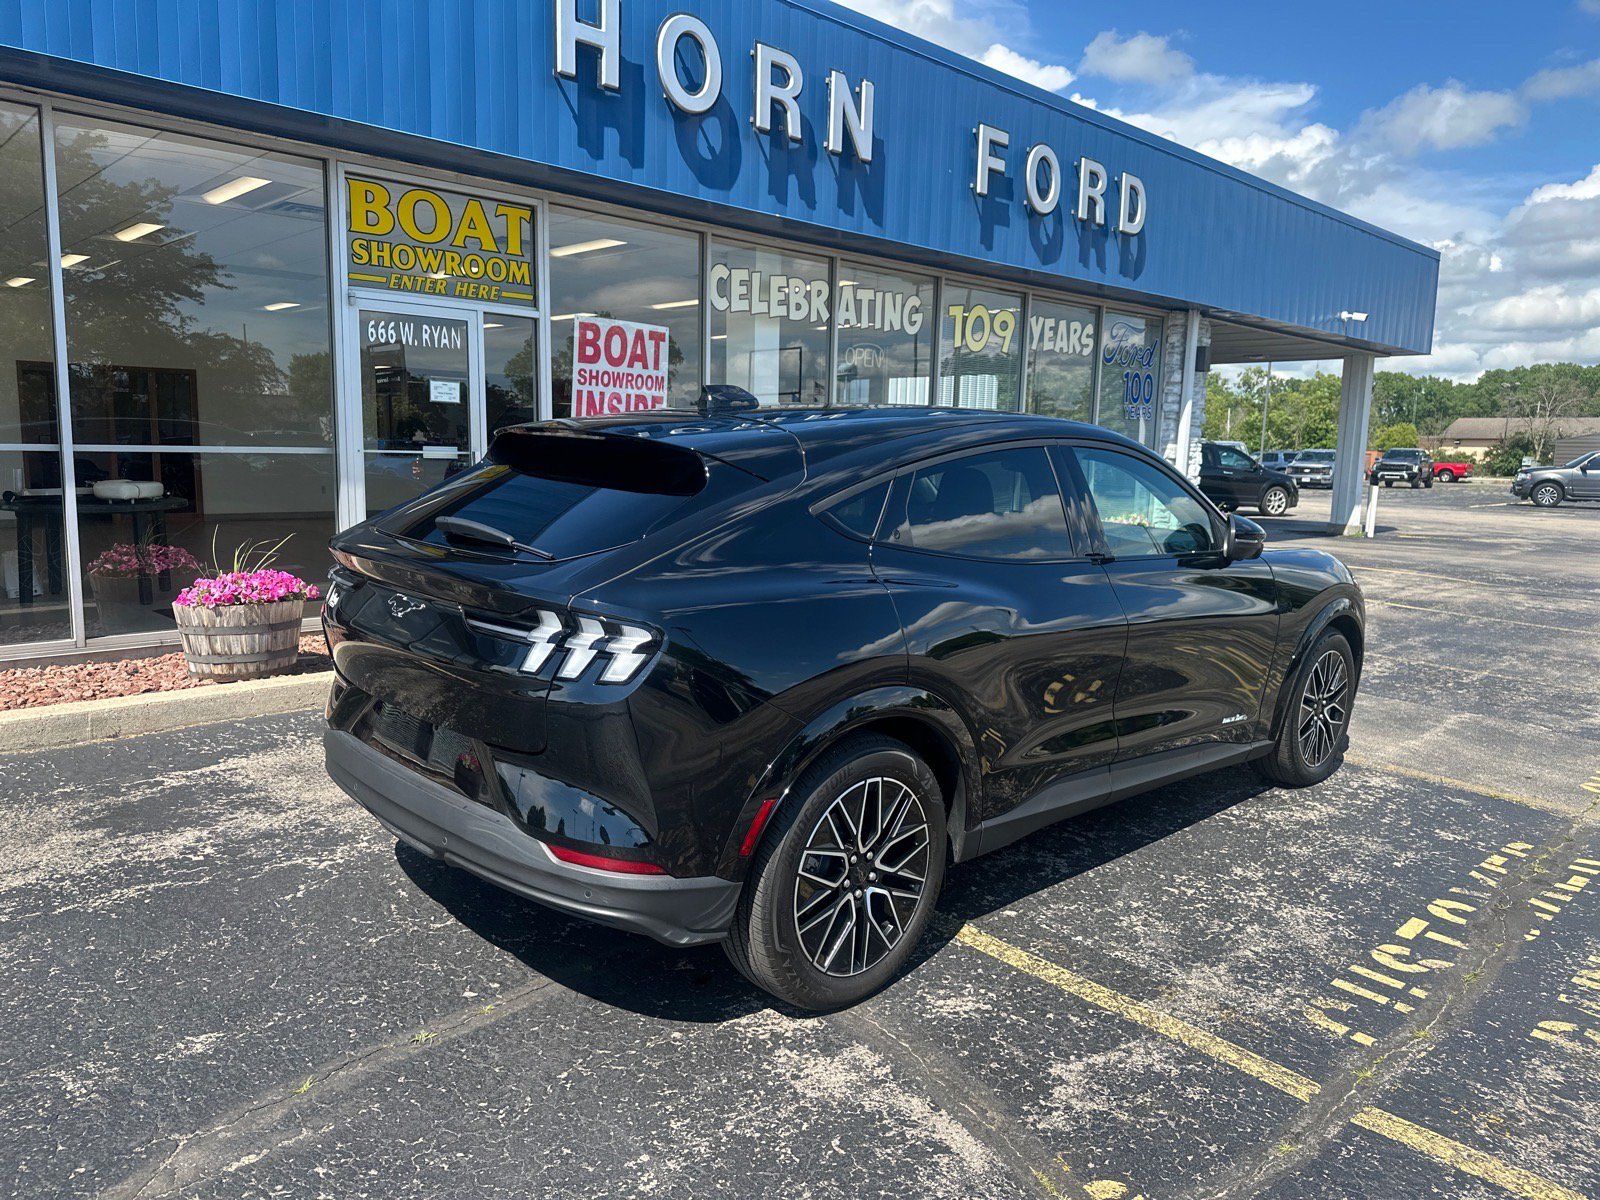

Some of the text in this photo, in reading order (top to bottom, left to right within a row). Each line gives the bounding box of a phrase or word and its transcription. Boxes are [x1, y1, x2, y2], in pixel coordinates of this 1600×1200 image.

[553, 0, 1147, 235] HORN FORD
[348, 176, 533, 258] BOAT
[351, 238, 532, 286] SHOWROOM
[388, 272, 502, 301] ENTER HERE
[710, 263, 1095, 357] CELEBRATING 109 YEARS
[367, 319, 462, 351] 666 W. RYAN
[577, 321, 666, 371] BOAT
[1103, 321, 1159, 368] Ford
[845, 346, 885, 369] OPEN
[577, 367, 666, 393] SHOWROOM
[1123, 369, 1154, 406] 100
[1123, 404, 1153, 420] YEARS
